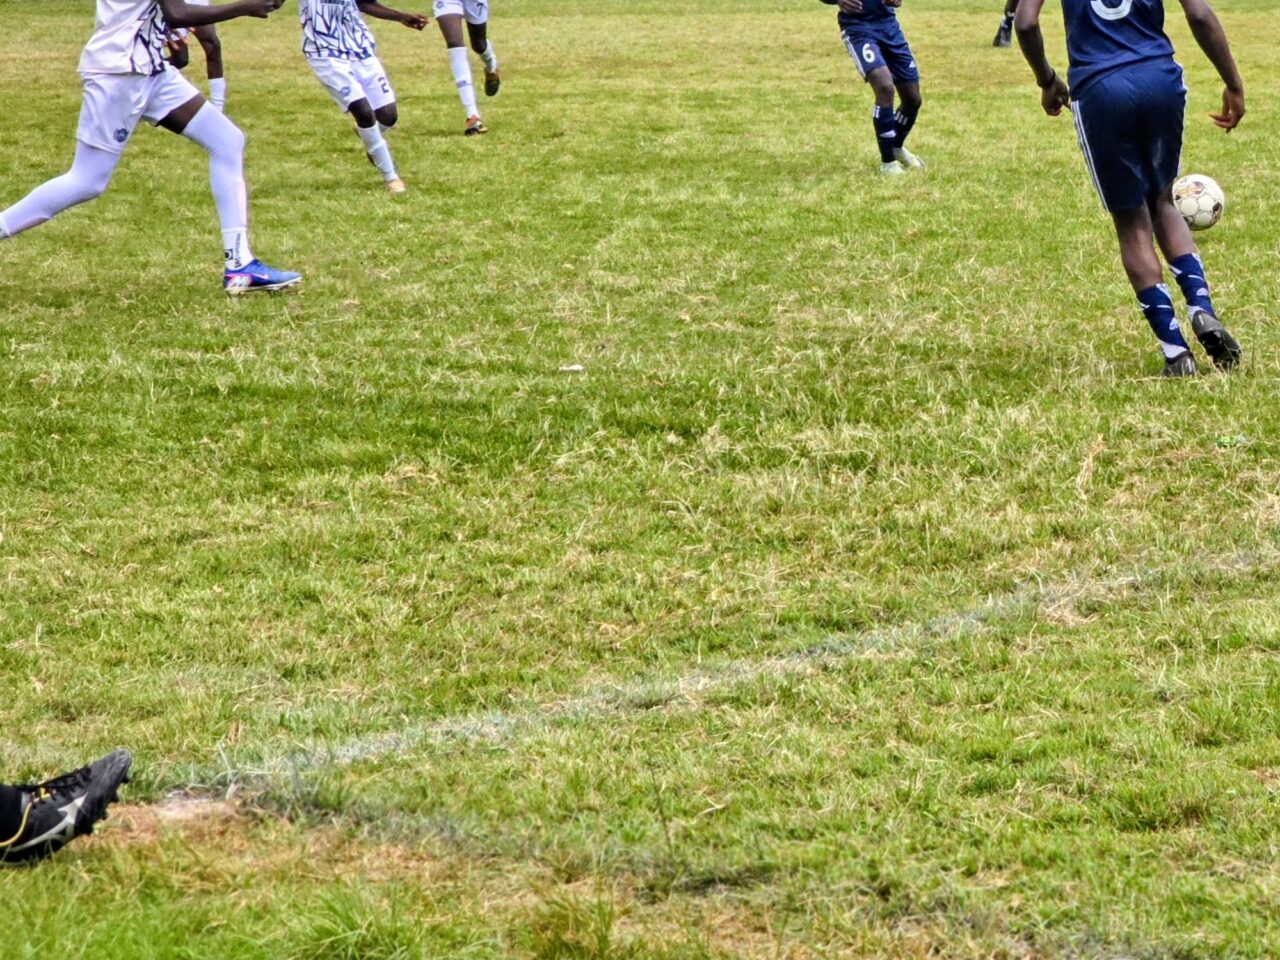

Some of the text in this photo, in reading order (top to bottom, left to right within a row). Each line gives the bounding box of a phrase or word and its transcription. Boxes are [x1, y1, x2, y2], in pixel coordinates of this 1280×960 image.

[476, 2, 484, 17] 7
[862, 42, 875, 64] 6
[377, 76, 389, 94] 2
